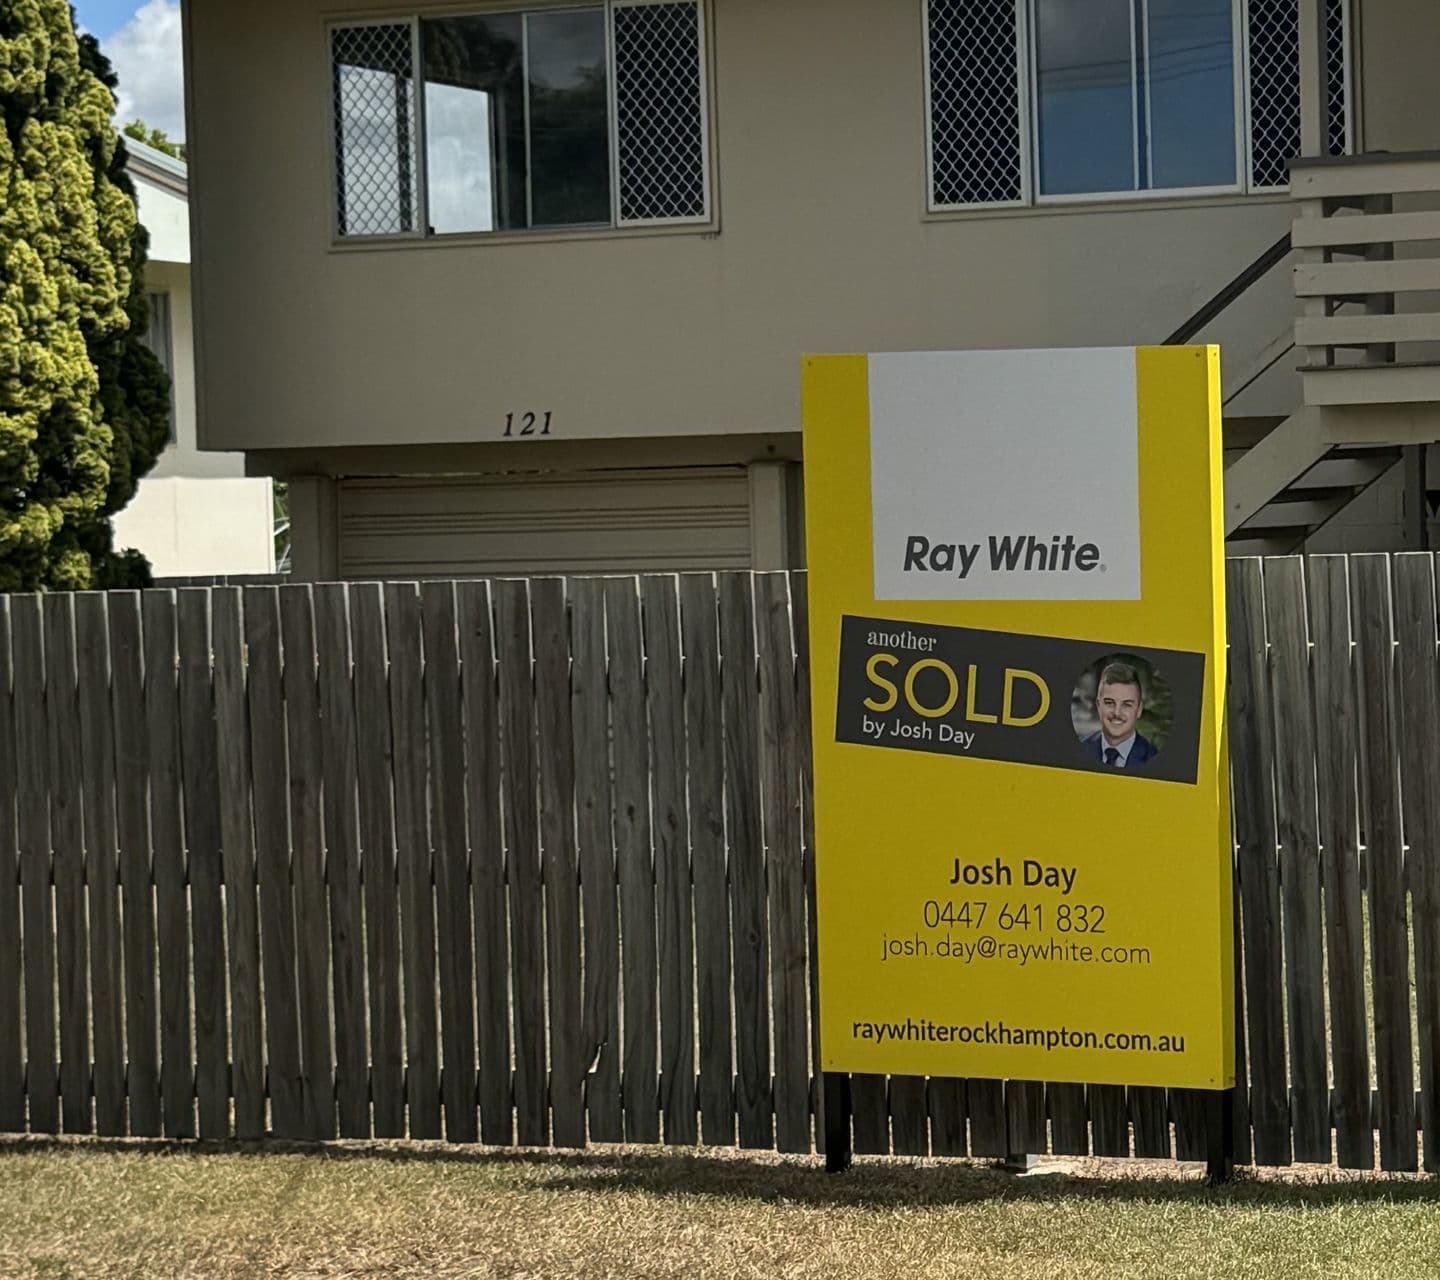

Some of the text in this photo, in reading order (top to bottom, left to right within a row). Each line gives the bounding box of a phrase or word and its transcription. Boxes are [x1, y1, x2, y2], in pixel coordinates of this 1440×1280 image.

[503, 411, 552, 437] 121
[904, 536, 1099, 579] Ray White
[867, 631, 937, 652] another
[863, 654, 1050, 727] SOLD
[862, 716, 975, 750] by Josh Day
[950, 858, 1077, 894] Josh Day
[924, 900, 1105, 933] 0447 641 832
[881, 933, 1151, 965] josh.day@raywhite.com
[852, 1019, 1185, 1052] raywhiterockhampton.com.au
